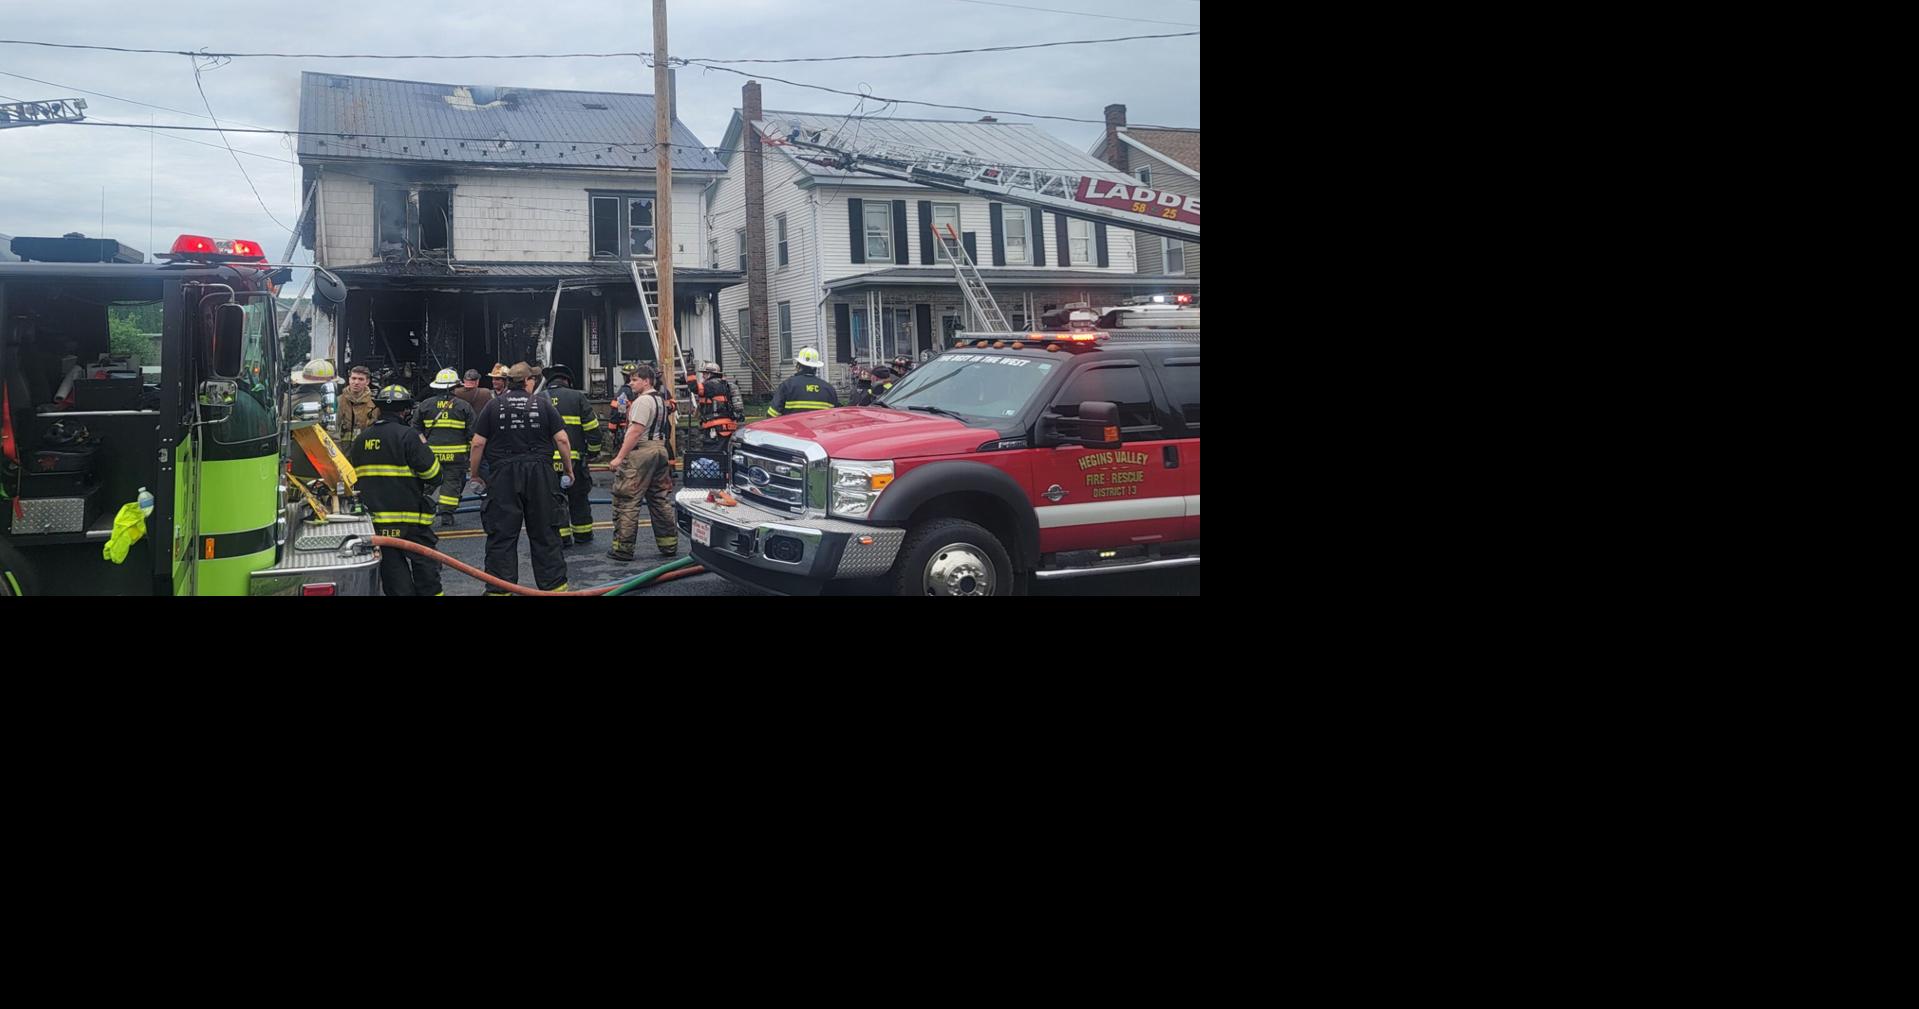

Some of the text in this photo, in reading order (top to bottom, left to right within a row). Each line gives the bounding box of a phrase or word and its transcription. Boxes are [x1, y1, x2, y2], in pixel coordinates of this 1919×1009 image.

[1131, 201, 1178, 219] 58 25
[999, 357, 1032, 367] WEST
[806, 384, 820, 393] MFC
[364, 439, 381, 450] MFC
[1078, 451, 1149, 470] HEGINS VALLEY
[1086, 473, 1105, 486] FIRE
[1111, 470, 1144, 484] RESCUE
[1093, 485, 1137, 498] DISTRICT 13
